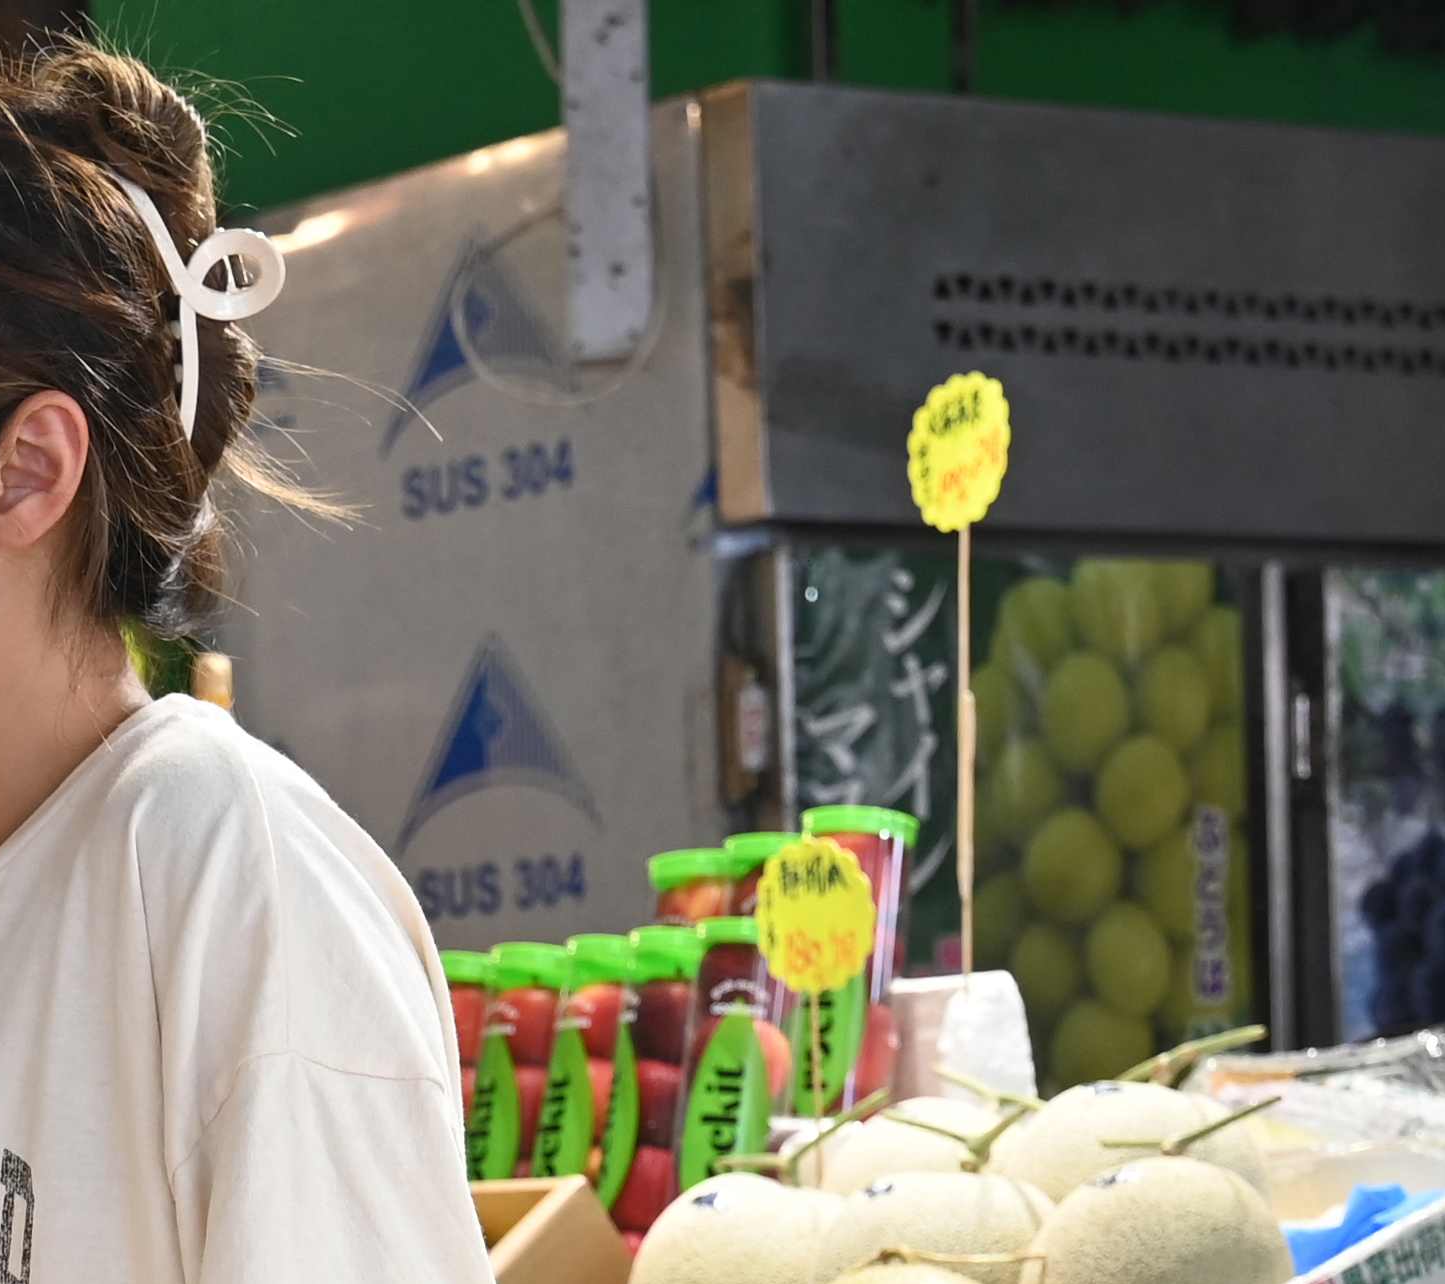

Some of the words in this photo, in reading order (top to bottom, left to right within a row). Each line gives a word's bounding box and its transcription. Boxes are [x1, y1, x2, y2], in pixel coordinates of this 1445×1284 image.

[400, 450, 490, 519] SUS
[500, 438, 575, 496] 304
[419, 863, 505, 919] SUS
[513, 854, 586, 908] 304
